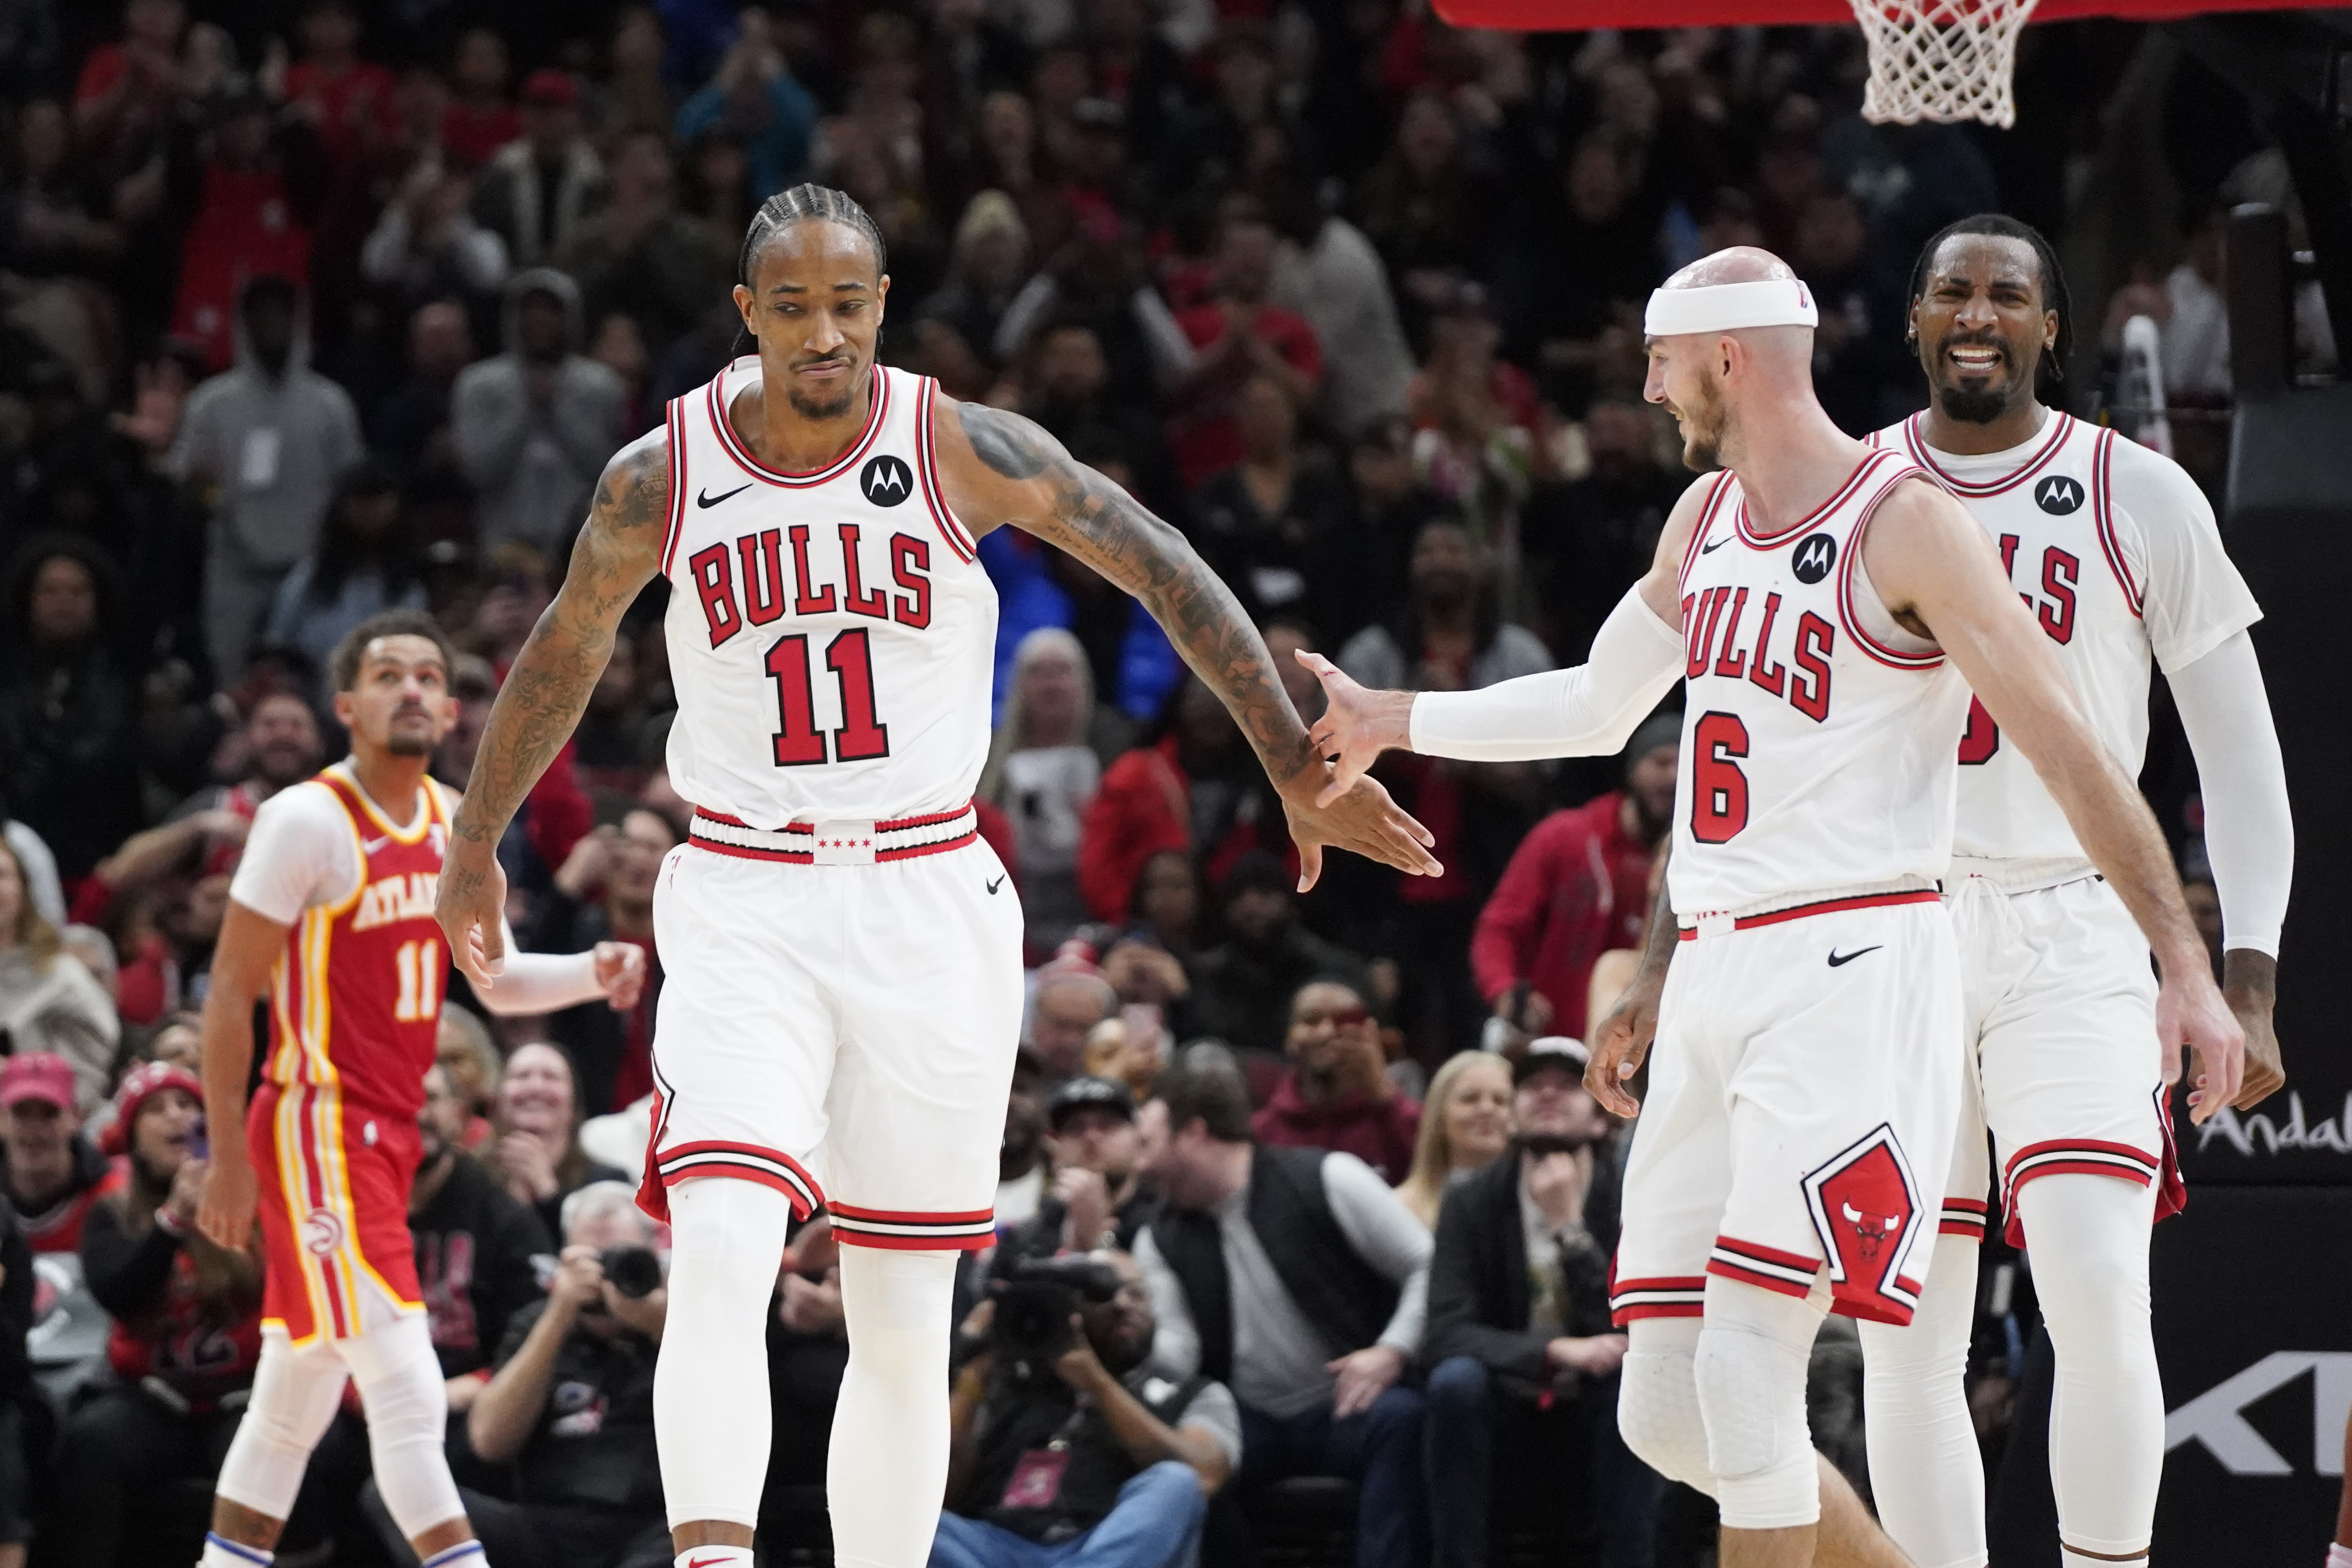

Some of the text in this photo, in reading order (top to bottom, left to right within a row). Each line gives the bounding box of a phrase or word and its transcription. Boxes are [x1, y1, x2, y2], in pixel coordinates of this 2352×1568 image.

[689, 524, 931, 650] BULLS
[764, 627, 890, 767] 11
[1690, 710, 1750, 844] 6
[394, 938, 437, 1022] 11
